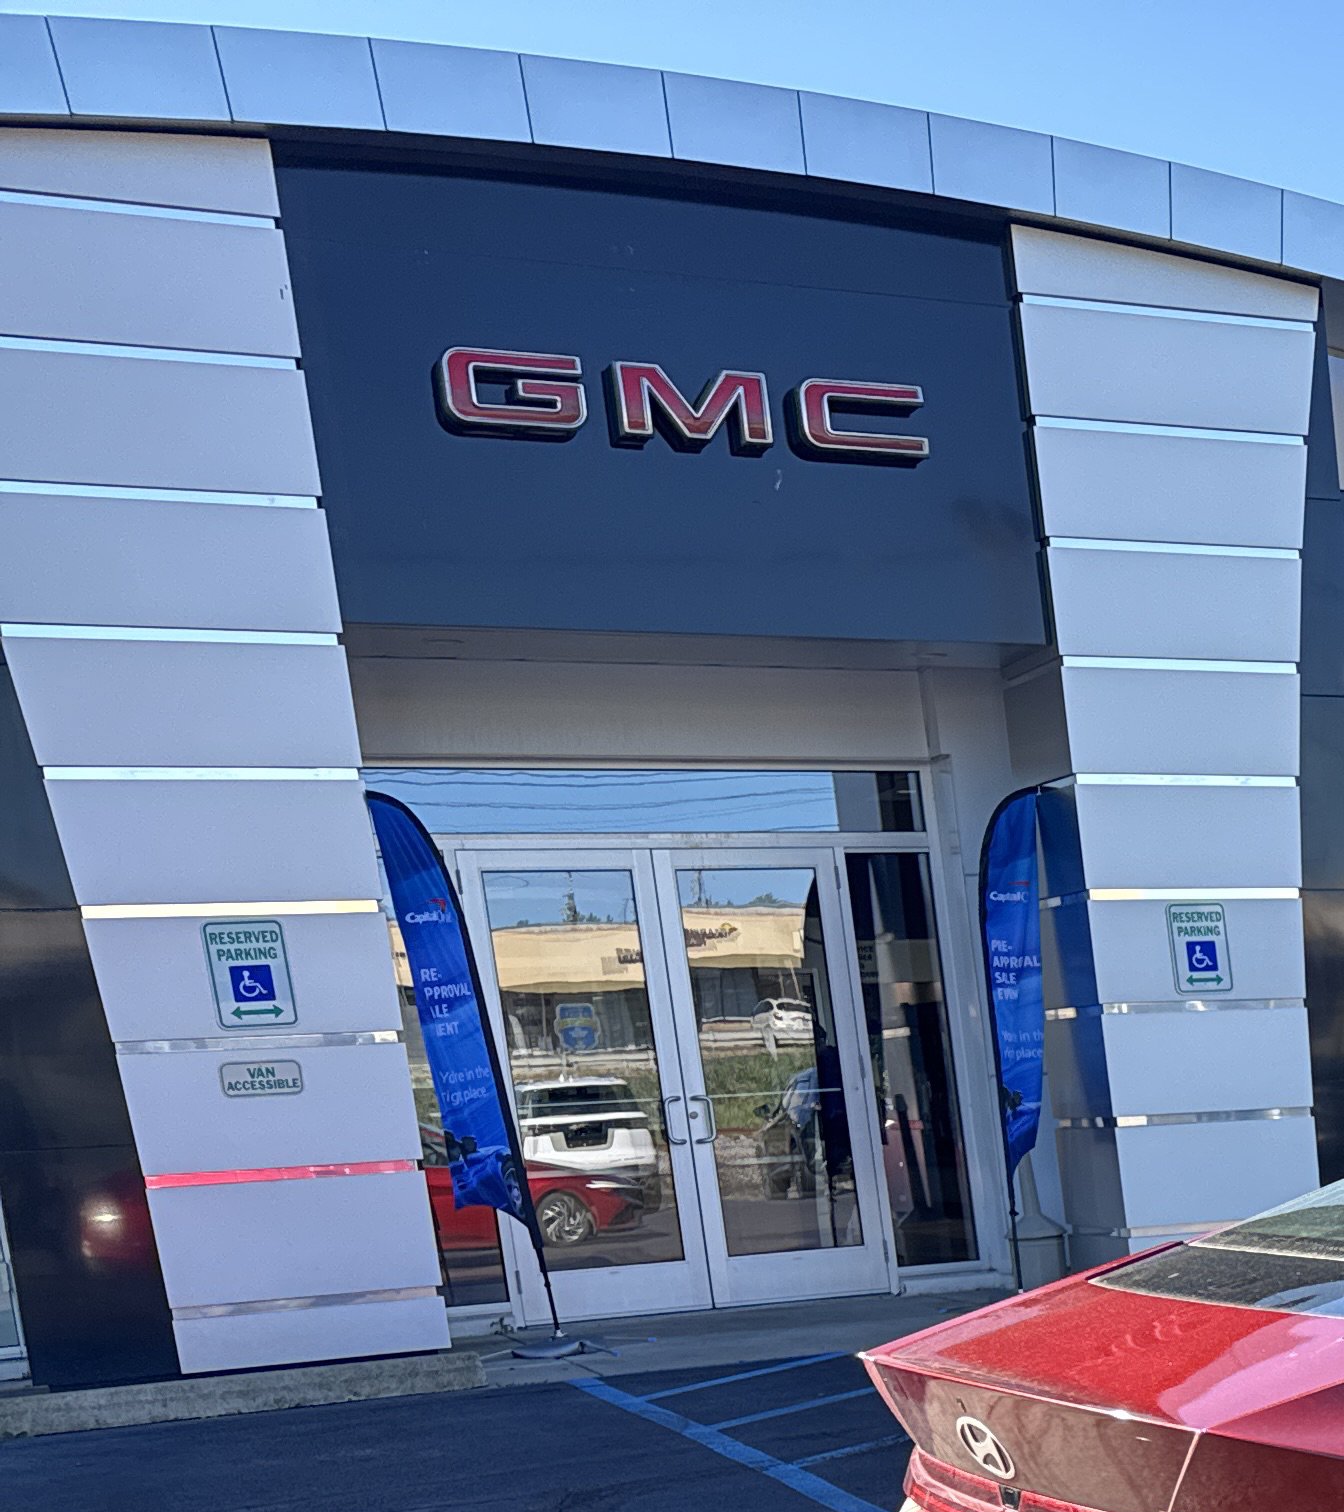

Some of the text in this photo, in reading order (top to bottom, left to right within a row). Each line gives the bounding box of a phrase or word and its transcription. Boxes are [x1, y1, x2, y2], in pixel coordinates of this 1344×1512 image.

[434, 346, 930, 463] GMC
[1171, 911, 1222, 923] RESERVED
[208, 930, 279, 946] RESERVED
[1176, 925, 1221, 937] PARKING
[215, 947, 278, 962] PARKING
[420, 967, 442, 982] RE-
[424, 982, 472, 1000] PPROVAL
[246, 1066, 276, 1079] VAN
[226, 1078, 300, 1092] ACCESSIBLE
